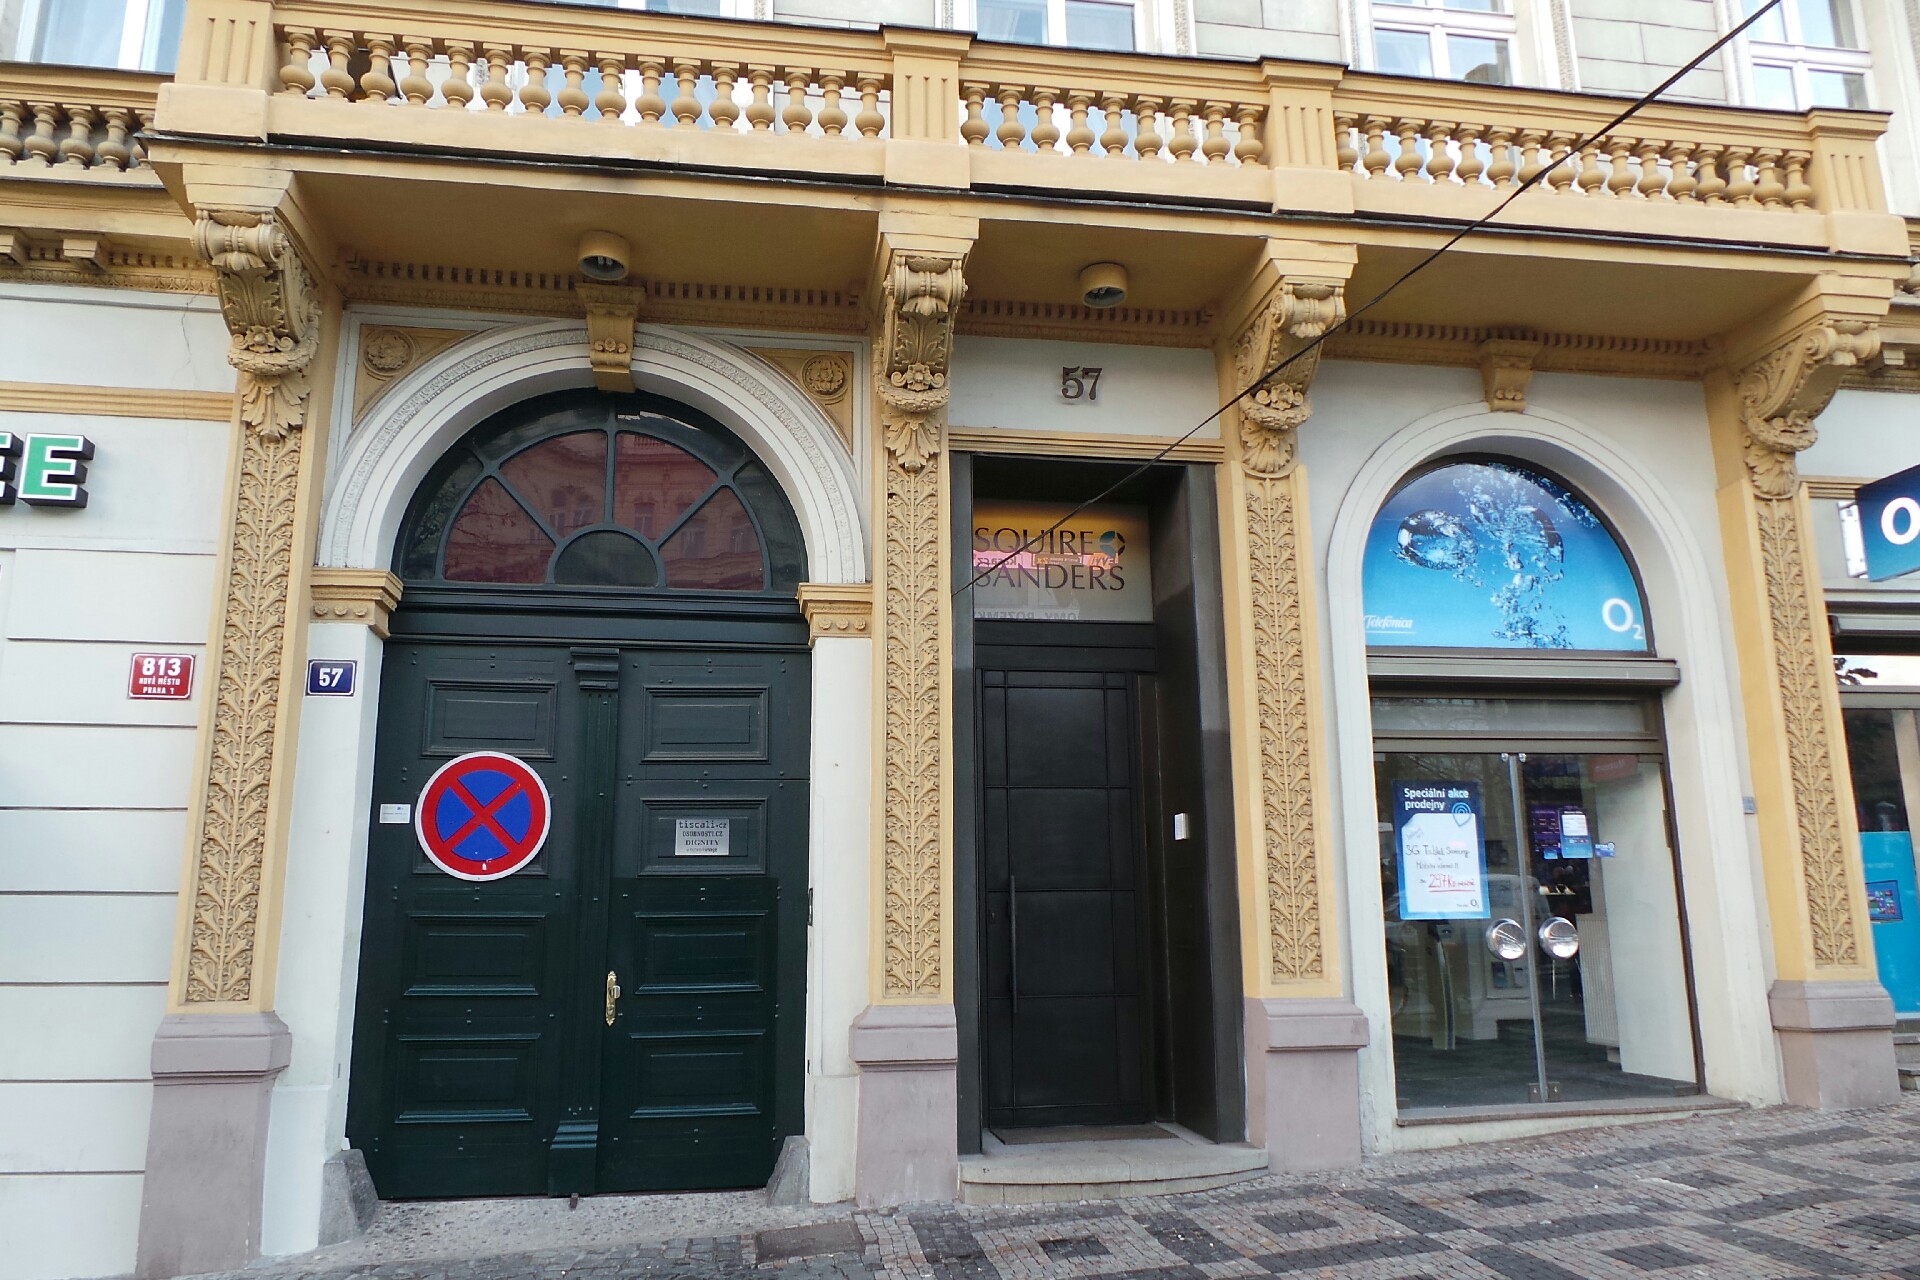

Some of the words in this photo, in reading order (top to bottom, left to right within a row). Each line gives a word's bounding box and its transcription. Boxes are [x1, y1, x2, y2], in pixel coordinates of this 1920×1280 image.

[1061, 366, 1102, 400] 57
[0, 431, 92, 507] E
[974, 527, 1094, 555] SQUIRE
[975, 562, 1125, 591] SANDERS
[142, 658, 181, 676] 813
[319, 667, 343, 687] 57
[142, 686, 166, 694] PRAHA
[1404, 788, 1445, 799] Speciální
[1447, 788, 1469, 798] akce
[1404, 799, 1445, 811] prodejny
